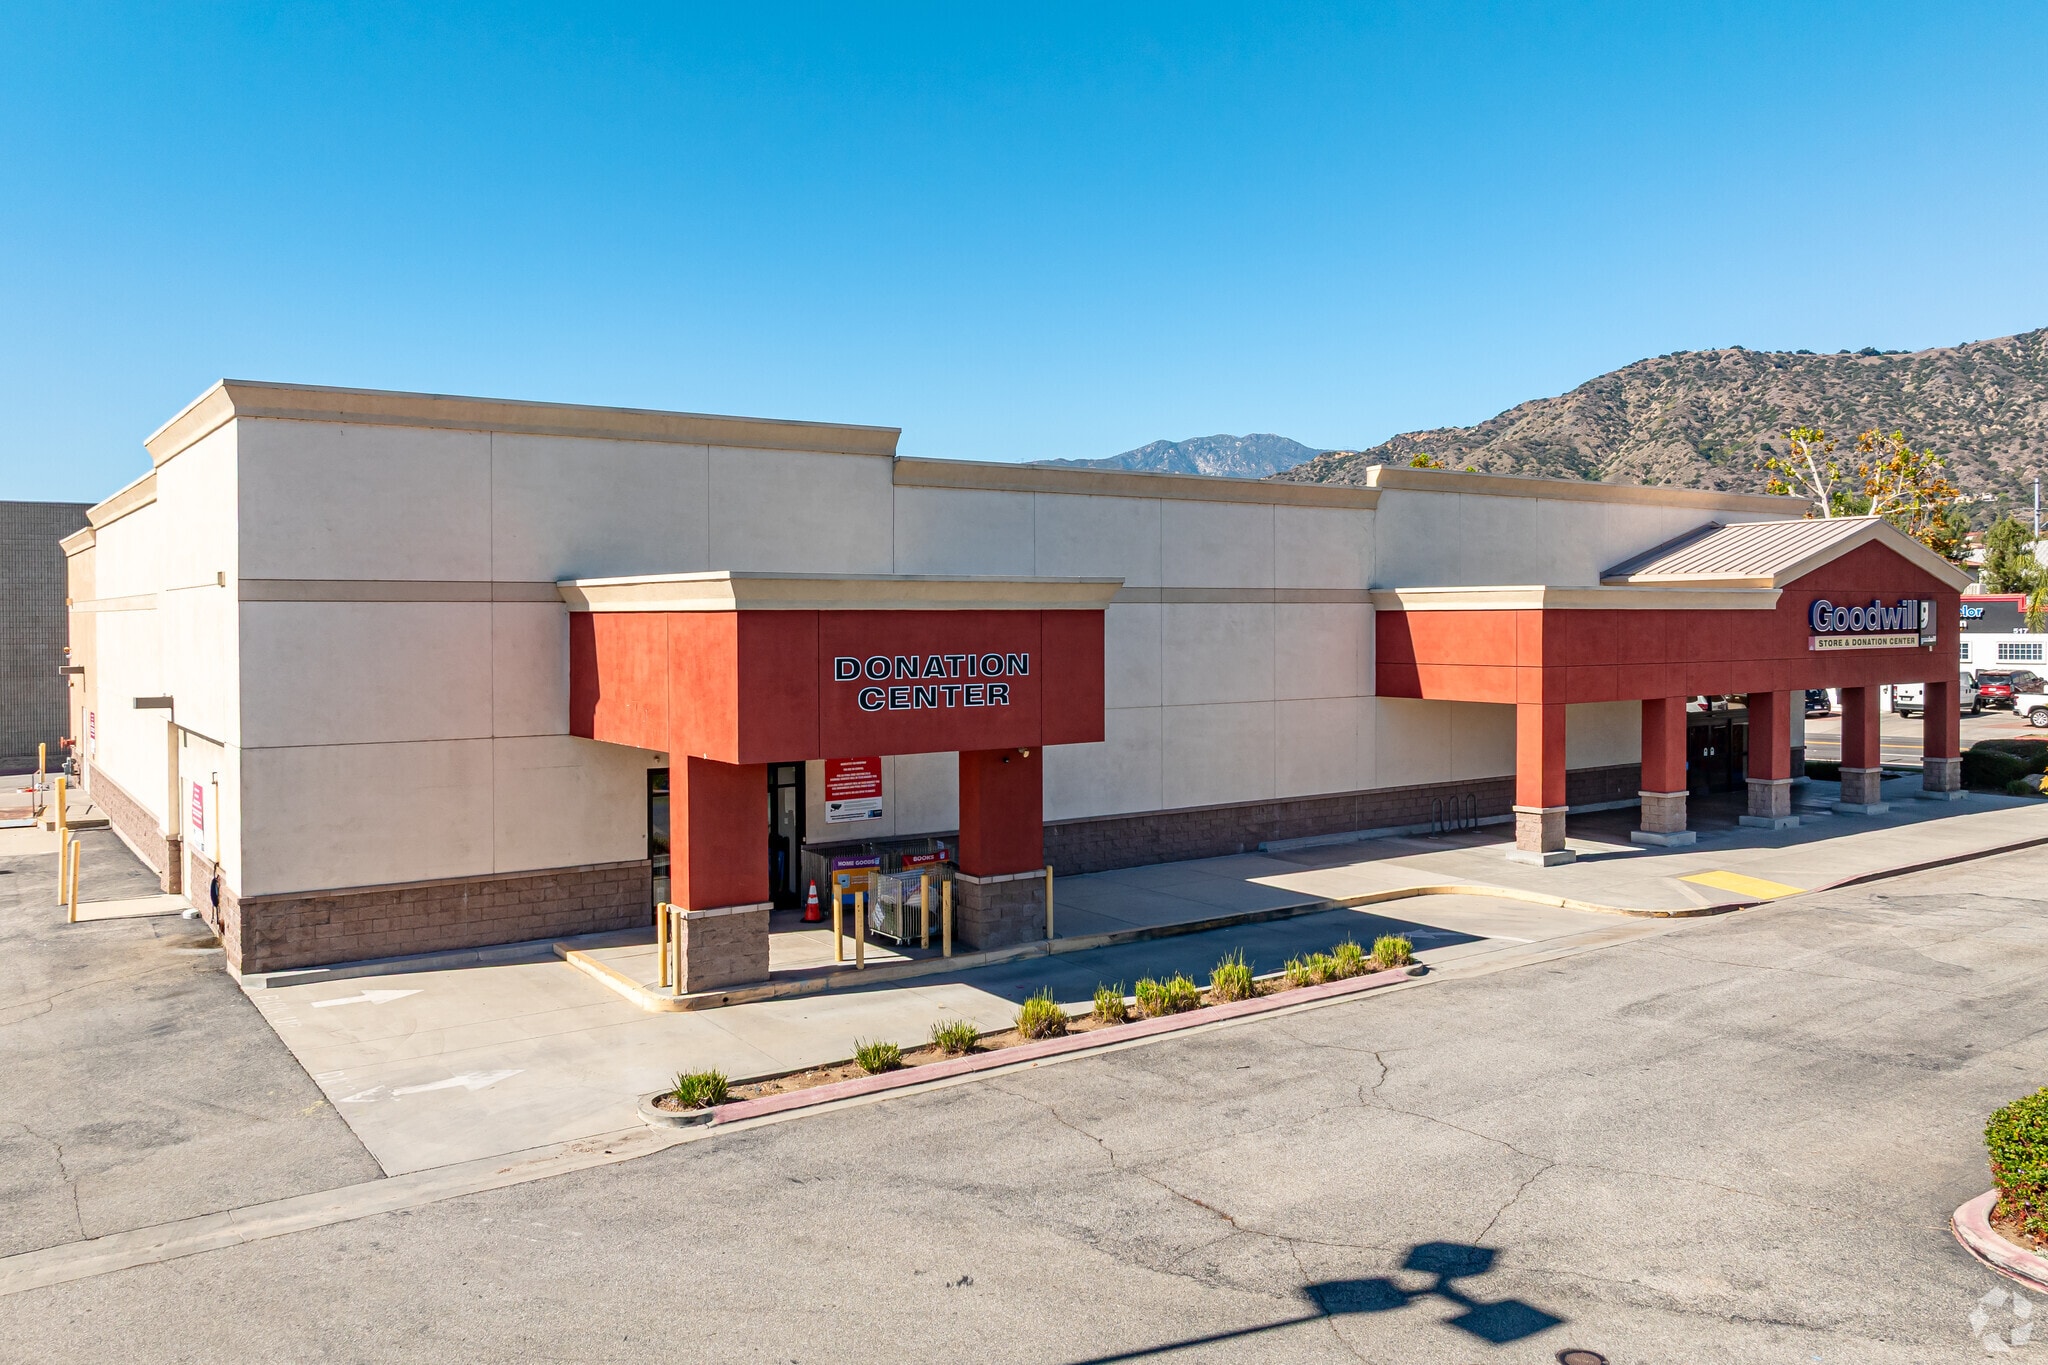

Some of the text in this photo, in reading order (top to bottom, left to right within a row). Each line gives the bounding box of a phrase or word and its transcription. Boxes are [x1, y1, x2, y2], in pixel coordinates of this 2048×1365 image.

[1809, 599, 1918, 632] Goodwill
[1818, 638, 1843, 648] STORE
[1844, 639, 1850, 647] &
[1852, 638, 1888, 646] DONATION
[1889, 637, 1915, 645] CENTER
[834, 653, 1029, 681] DONATION
[858, 683, 1010, 712] CENTER
[912, 854, 935, 862] BOOKS
